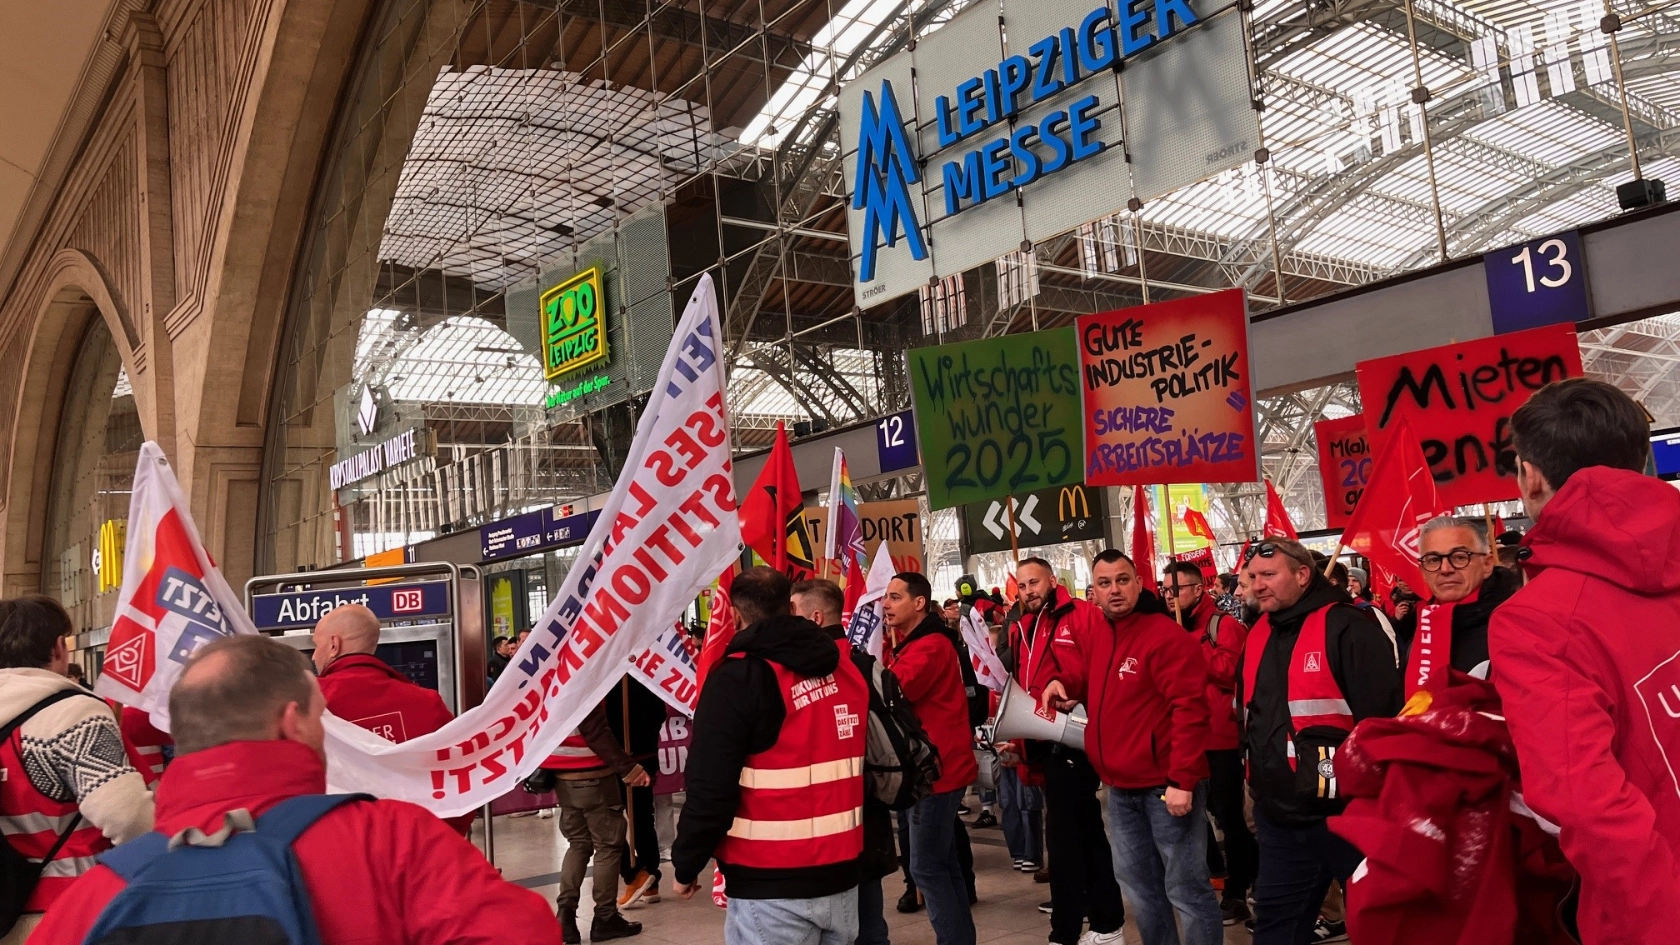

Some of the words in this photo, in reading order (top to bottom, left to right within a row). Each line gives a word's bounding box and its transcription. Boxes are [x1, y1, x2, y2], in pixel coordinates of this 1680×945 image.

[935, 0, 1200, 148] LEIPZIGER
[943, 94, 1106, 216] MESSE
[1511, 238, 1572, 293] 13
[546, 282, 594, 335] ZOO
[549, 327, 596, 368] LEIPZIG
[1084, 318, 1144, 356] GUTE
[1150, 351, 1240, 403] POLITIK
[1378, 348, 1568, 428] Mieten
[879, 416, 905, 450] 12
[1093, 405, 1175, 436] SICHERE
[945, 428, 1072, 490] 2025
[1088, 428, 1245, 478] ARBEITSPLÄTZE
[395, 591, 421, 609] DB
